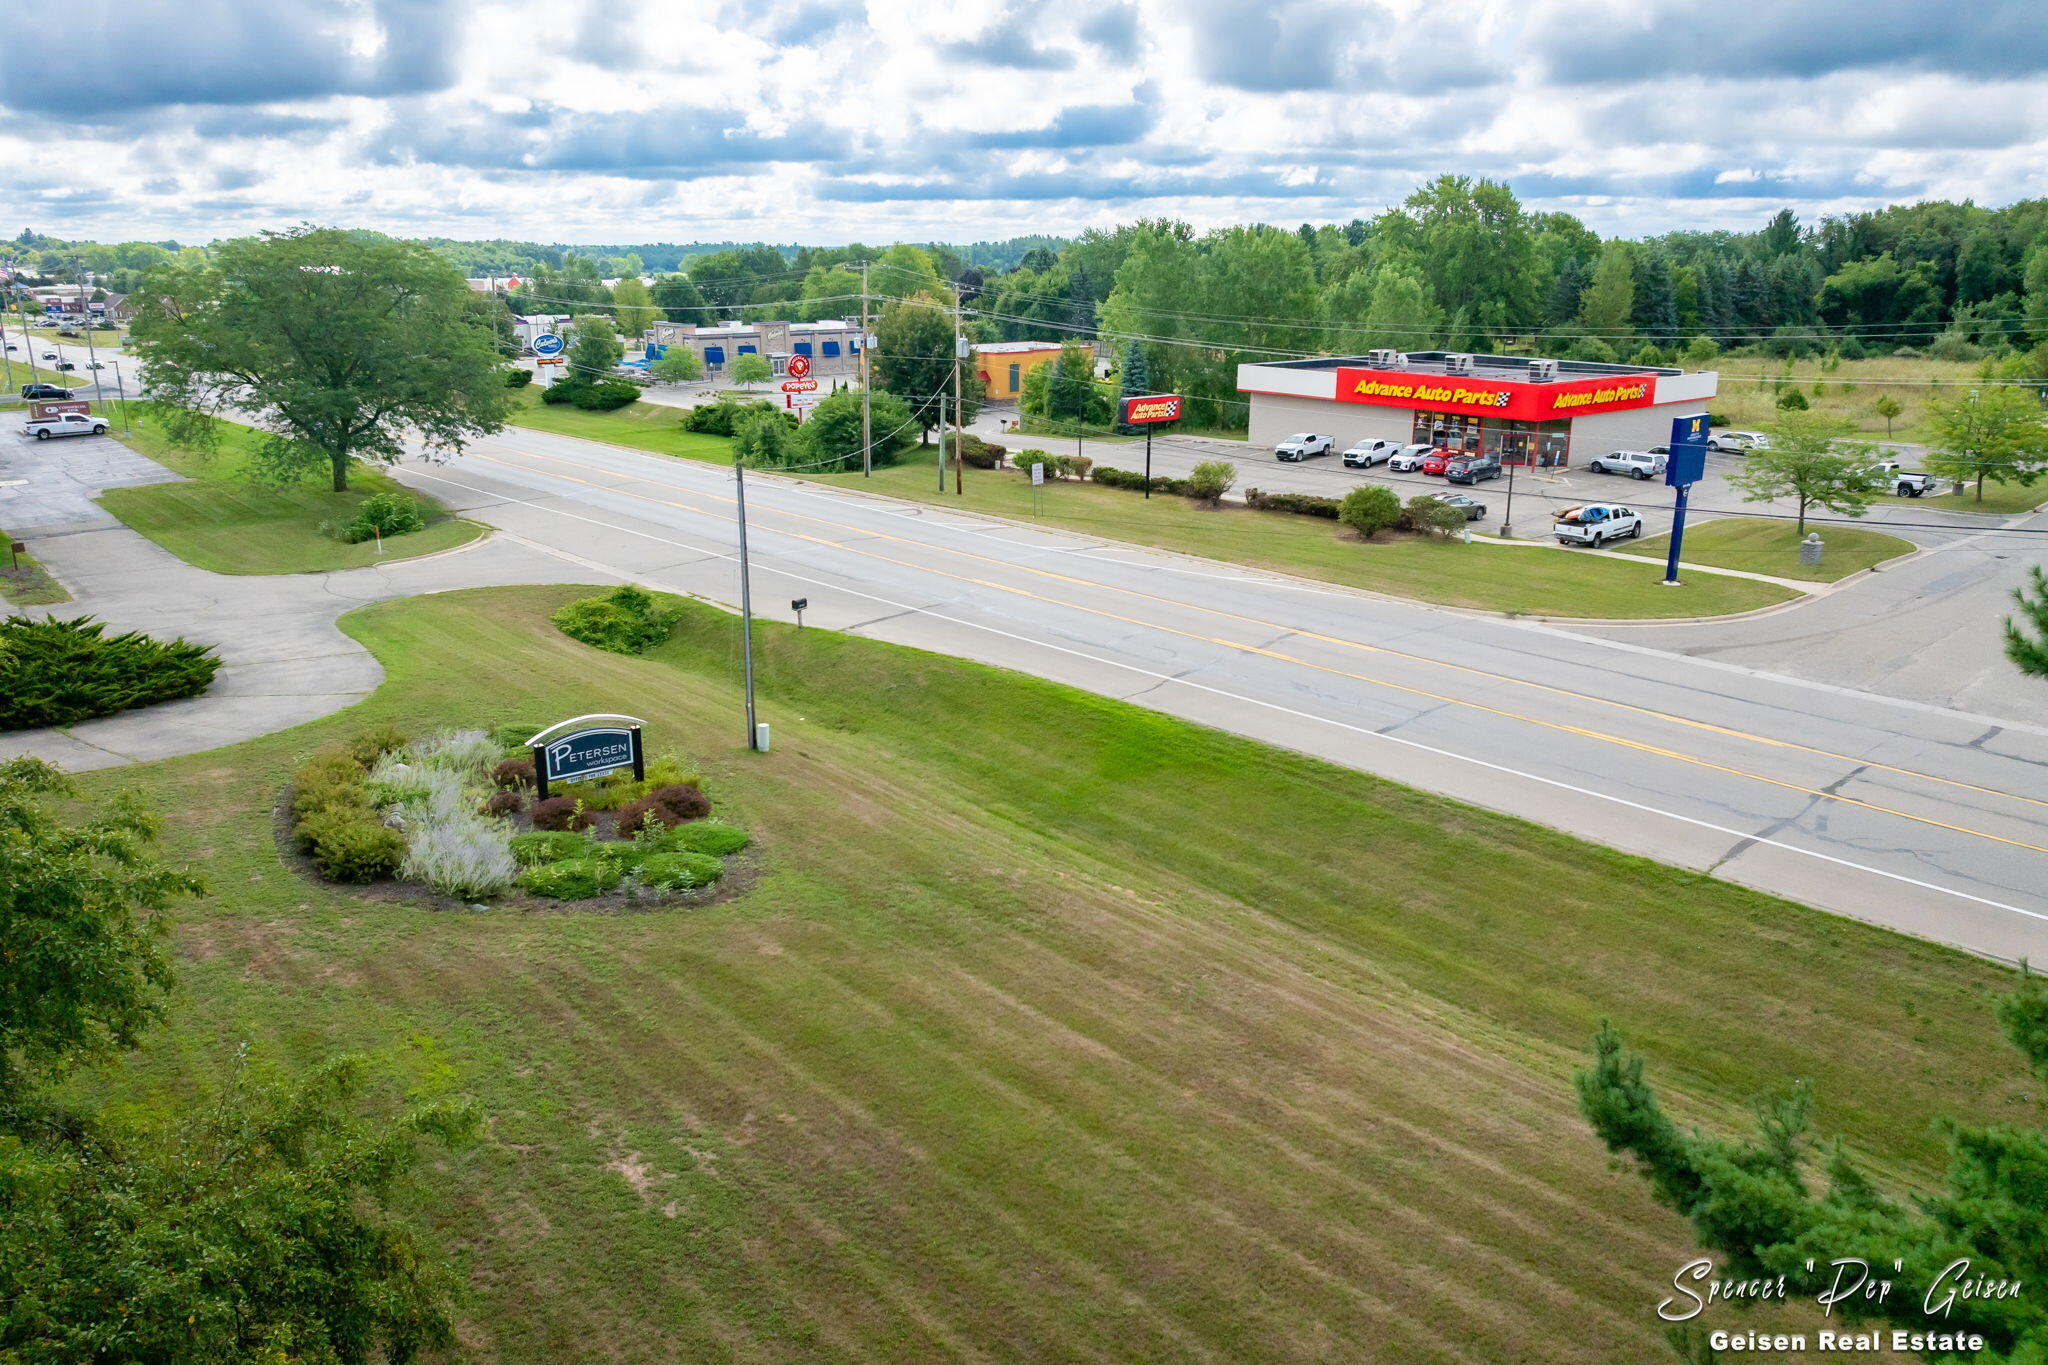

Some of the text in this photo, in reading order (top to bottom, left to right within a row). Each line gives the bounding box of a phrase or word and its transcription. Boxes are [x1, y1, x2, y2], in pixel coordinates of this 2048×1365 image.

[786, 382, 816, 390] POPEYES
[1354, 379, 1495, 405] Advance Auto Parts
[1553, 385, 1639, 408] Advance Auto Parts
[1135, 403, 1165, 411] Advance
[1130, 410, 1165, 419] Auto Parts
[552, 743, 627, 771] PETERSEN
[586, 754, 628, 767] workspace
